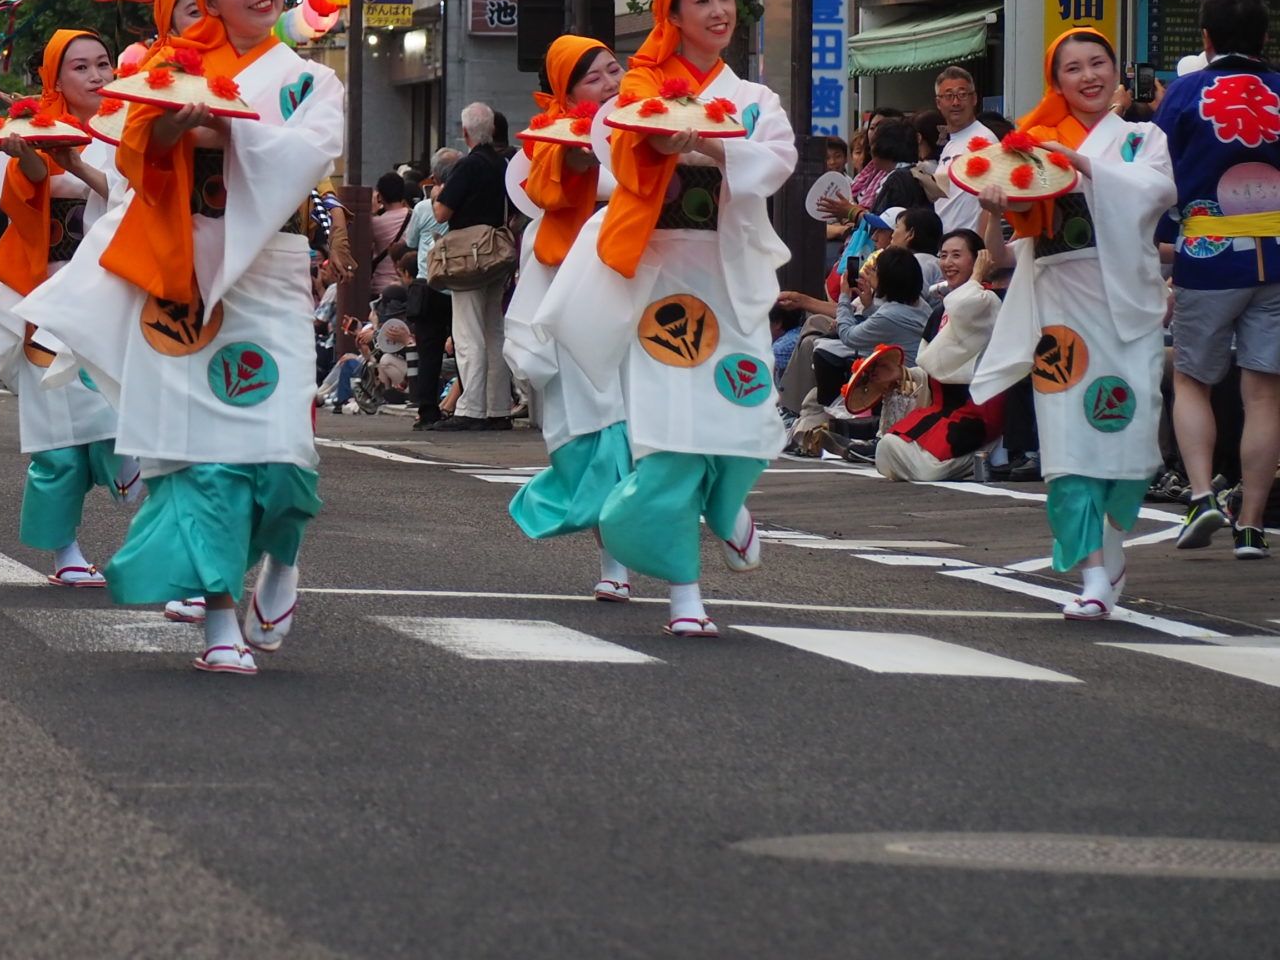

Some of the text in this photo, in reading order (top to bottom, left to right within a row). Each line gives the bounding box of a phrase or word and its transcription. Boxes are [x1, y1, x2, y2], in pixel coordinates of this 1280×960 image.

[367, 5, 411, 16] がんばれ
[1199, 74, 1280, 148] 祭
